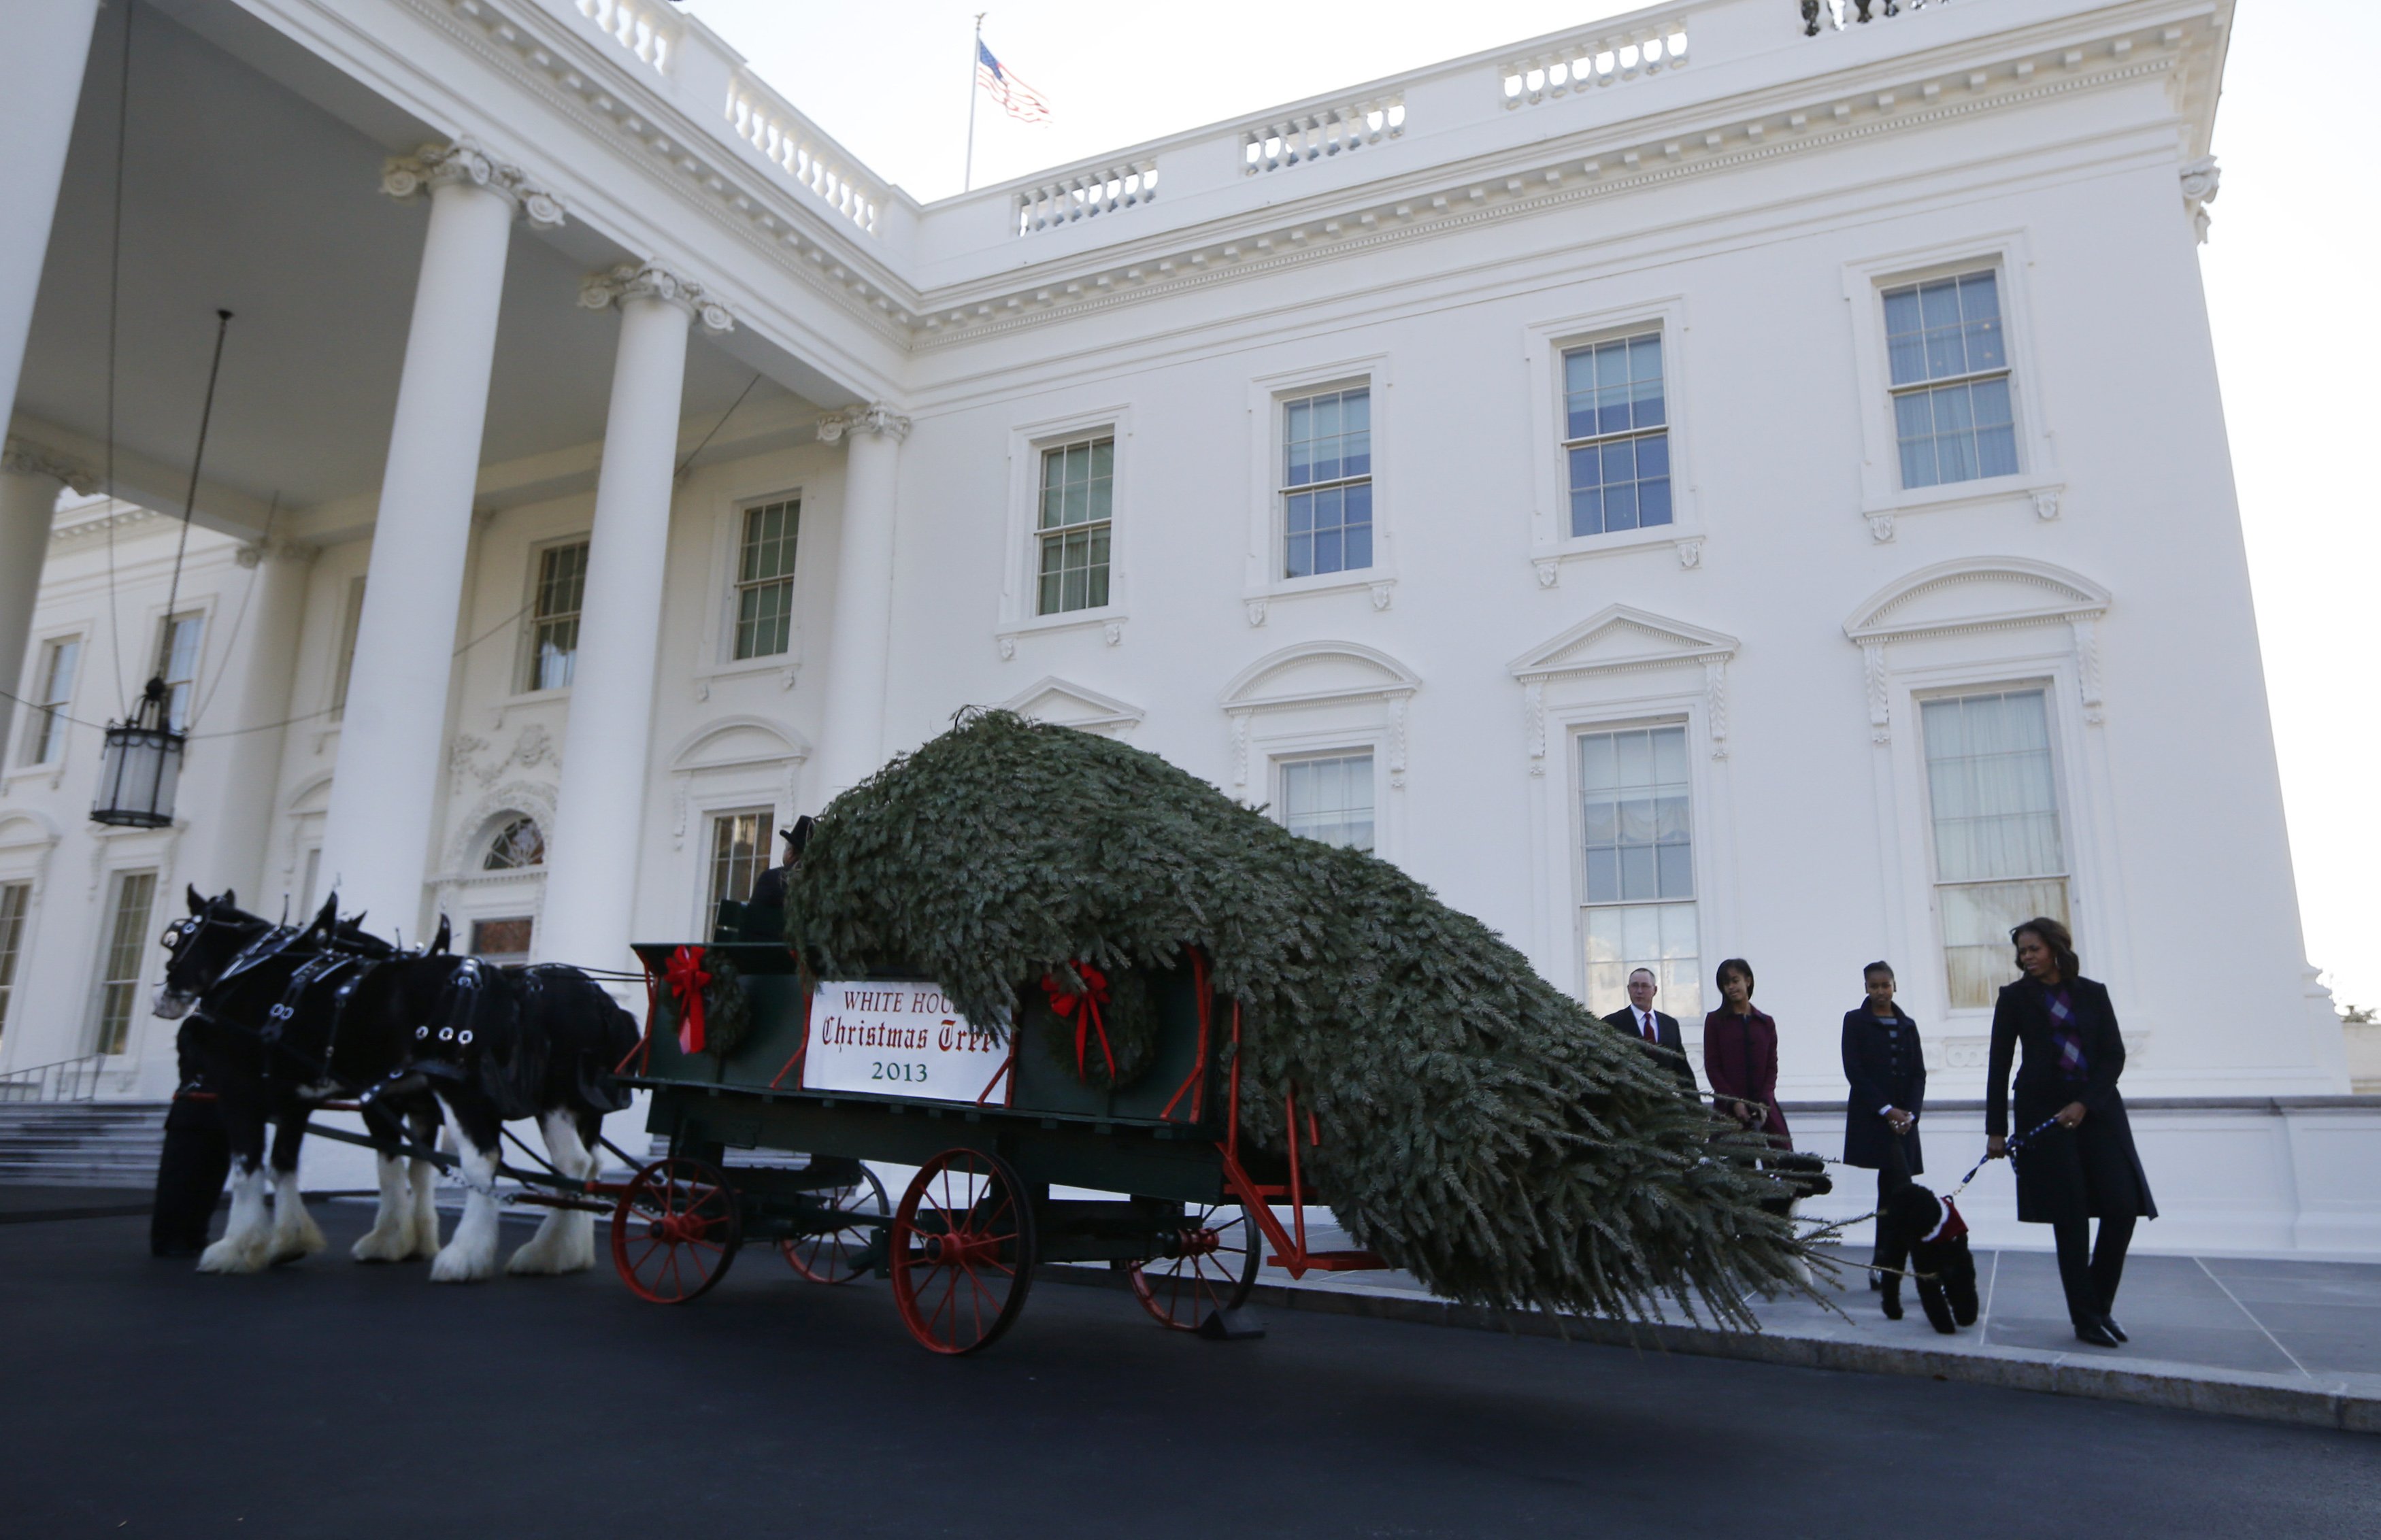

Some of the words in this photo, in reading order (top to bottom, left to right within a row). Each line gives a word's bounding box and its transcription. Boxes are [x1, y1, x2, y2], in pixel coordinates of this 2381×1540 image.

[844, 991, 904, 1012] WHITE
[911, 992, 956, 1014] HOU
[822, 1016, 929, 1053] Christmas
[938, 1019, 993, 1054] Tree
[871, 1061, 929, 1082] 2013
